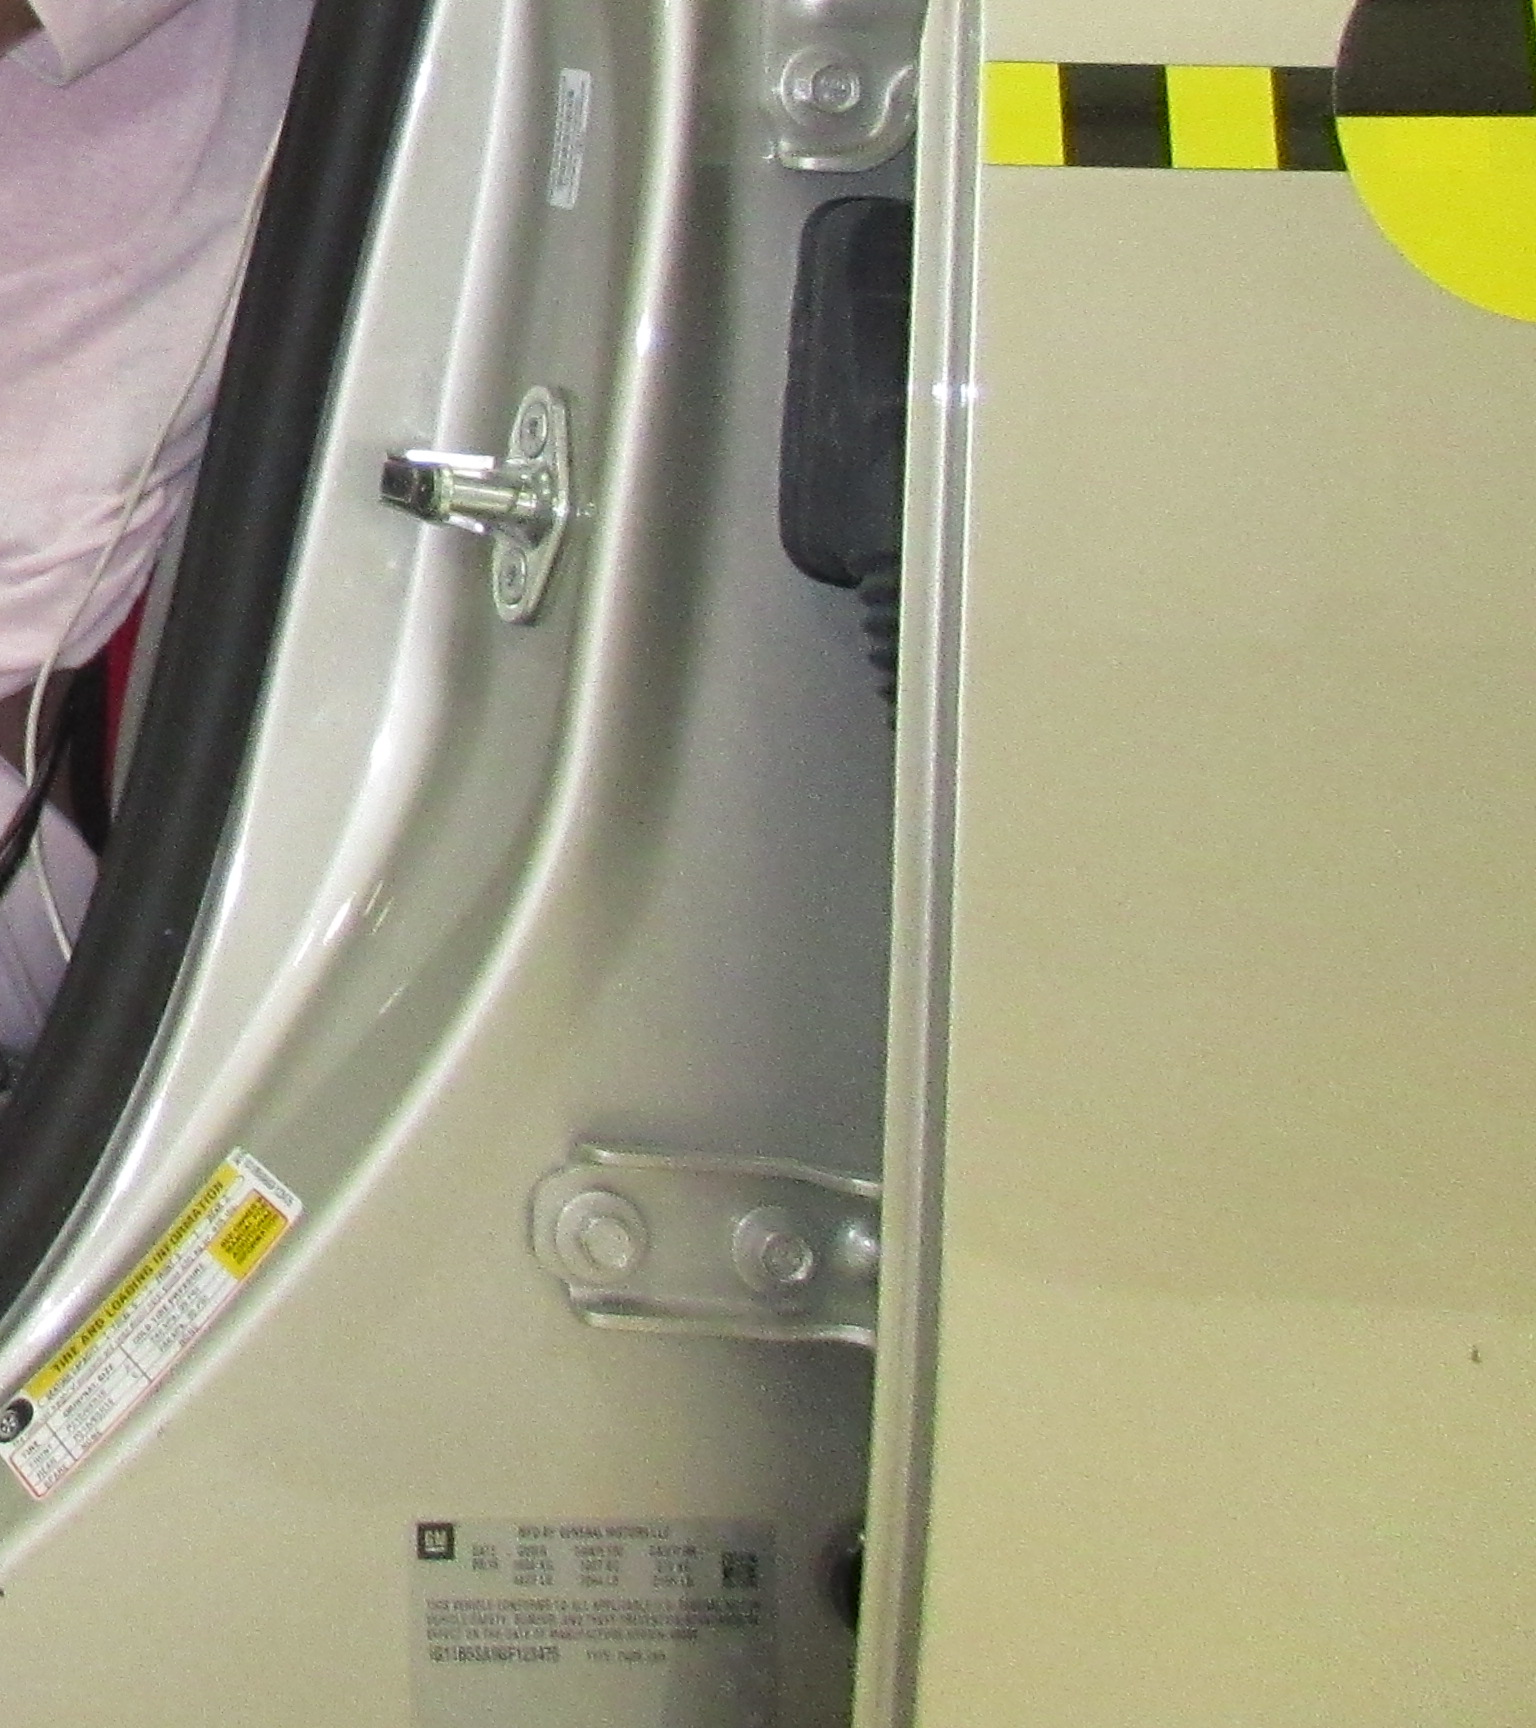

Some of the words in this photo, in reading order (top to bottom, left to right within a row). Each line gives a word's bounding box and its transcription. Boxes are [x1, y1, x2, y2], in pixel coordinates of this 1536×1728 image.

[51, 1344, 79, 1373] TIRE
[77, 1316, 106, 1345] AND
[102, 1262, 154, 1318] LOADING
[148, 1179, 227, 1264] INFORMATION
